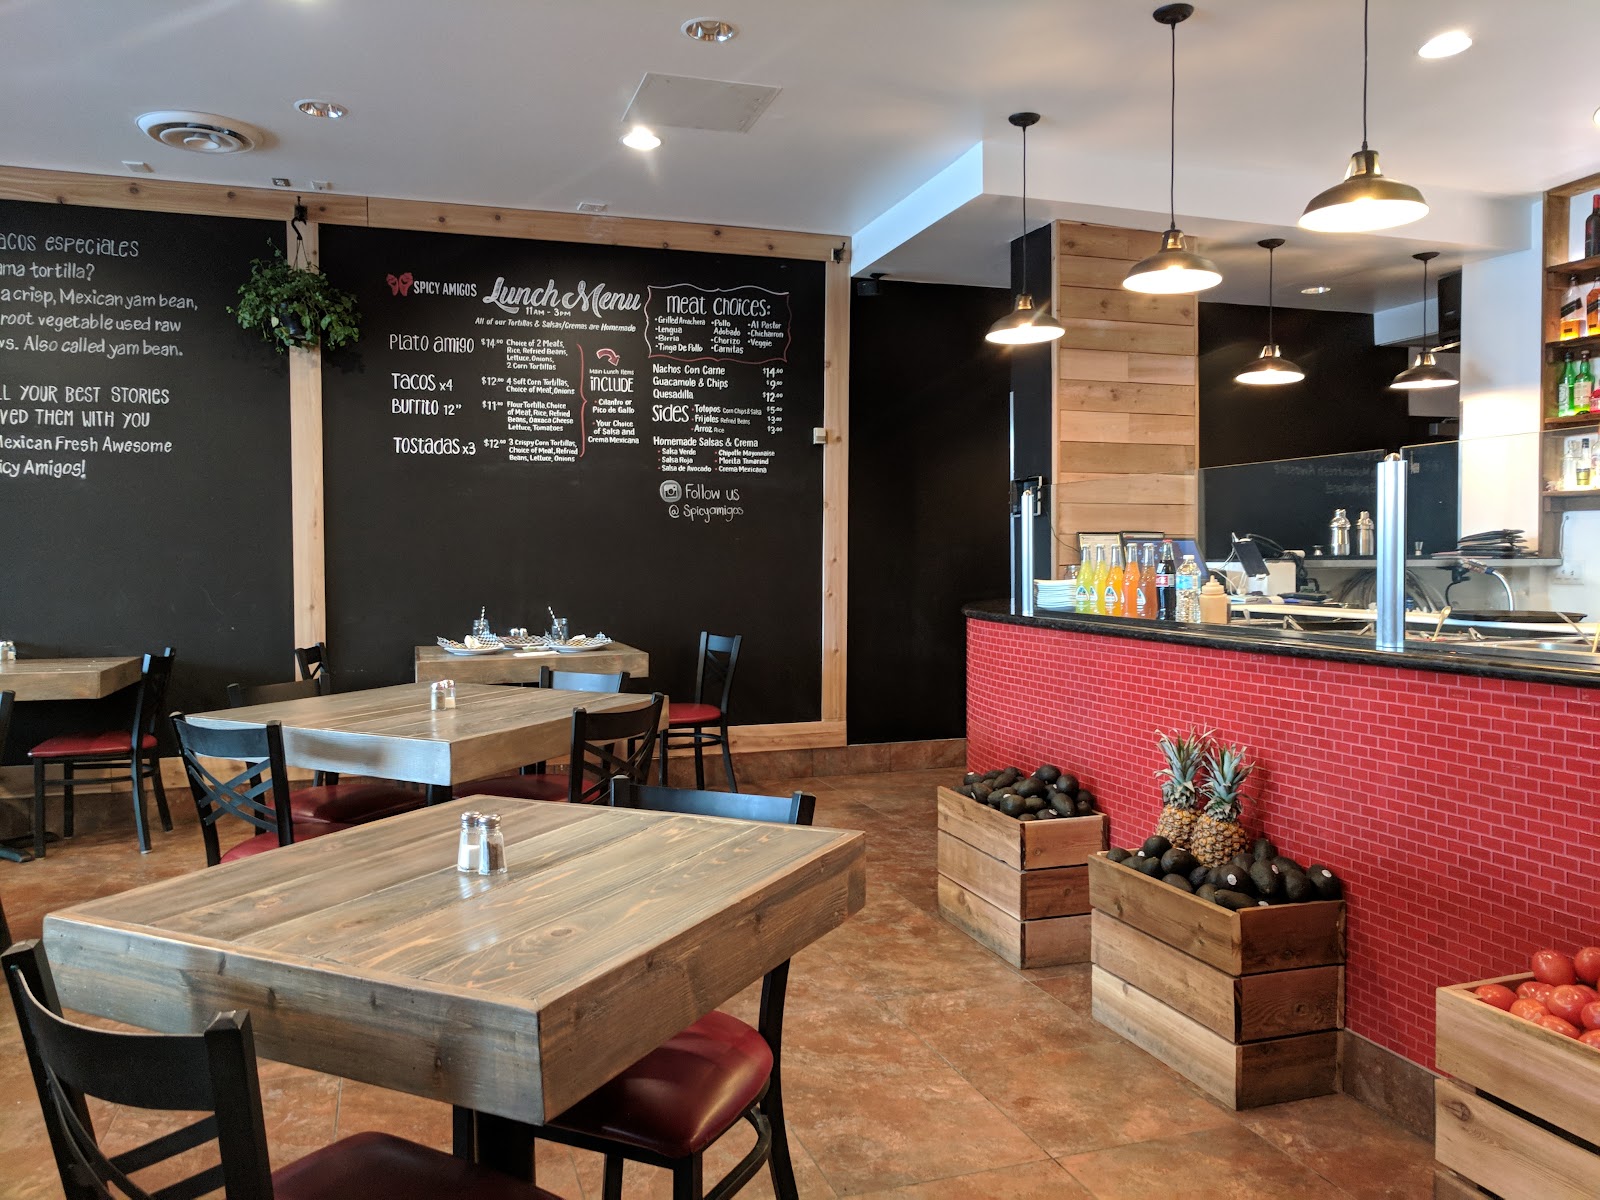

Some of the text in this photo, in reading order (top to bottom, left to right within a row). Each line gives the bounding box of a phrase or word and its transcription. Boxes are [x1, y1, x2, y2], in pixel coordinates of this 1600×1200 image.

[45, 236, 139, 257] especiales
[30, 262, 95, 281] tortilla?
[413, 281, 477, 297] SPICY AMIGOS
[13, 286, 198, 311] crisp, Mexican yam bean,
[482, 276, 641, 318] Lunch Menu
[1, 312, 181, 332] root vegetable used raw
[475, 317, 484, 325] All
[507, 318, 533, 327] Tortillas
[601, 323, 637, 333] Homemade
[658, 316, 706, 326] Grilled Arrachera
[750, 320, 782, 330] Al Pastor
[658, 326, 682, 335] Lengua
[713, 319, 741, 337] Pollo Adobado
[389, 333, 475, 353] Plato amigo
[506, 339, 527, 347] Choice
[528, 339, 535, 347] of
[537, 339, 542, 347] 2
[713, 336, 741, 345] Chorizo
[750, 338, 773, 349] Veggie
[23, 335, 183, 359] Also called yam bean.
[523, 347, 546, 355] Refried
[658, 342, 703, 354] Tinga De Pollo
[713, 345, 744, 354] Carnitas
[529, 362, 557, 370] Tortillas
[652, 363, 726, 376] Nachos Con Carne
[391, 372, 453, 391] Tacos x4
[506, 377, 512, 385] 4
[526, 378, 542, 386] Corn
[652, 376, 729, 390] Guacamole & Chips
[506, 385, 527, 393] Choice
[652, 388, 694, 400] Quesadilla
[20, 385, 58, 404] YOUR
[391, 398, 439, 416] Burrito
[507, 400, 523, 408] Flour
[598, 398, 623, 406] Cilantro
[617, 406, 635, 414] Gallo
[694, 403, 721, 414] Totopos
[81, 410, 114, 428] WITH
[122, 412, 150, 429] YOU
[552, 417, 574, 425] Cheese
[595, 419, 634, 428] Your Choice
[694, 414, 719, 424] Frijoles
[532, 424, 564, 432] Tomatoes
[602, 428, 620, 436] Salsa
[693, 424, 713, 433] Arroz
[0, 435, 172, 453] exican Fresh Awesome
[514, 439, 534, 447] Crispy
[587, 435, 640, 444] Crema Mexicana
[652, 436, 759, 448] Homemade Salsas & Crema
[393, 437, 476, 455] Tostadas x3
[508, 446, 530, 454] Choice
[556, 447, 579, 455] Refried
[661, 447, 697, 456] Salsa Verde
[718, 449, 775, 458] Chipotle Mayonnaise
[661, 456, 694, 465] Salsa Roja
[718, 456, 769, 465] Morita Tamarind
[23, 459, 86, 479] Amigos!
[661, 464, 677, 472] Salsa
[686, 465, 712, 473] Avocado
[738, 466, 767, 474] Mexicana
[685, 483, 740, 501] Follow us
[668, 504, 744, 523] @ Spicyamigos
